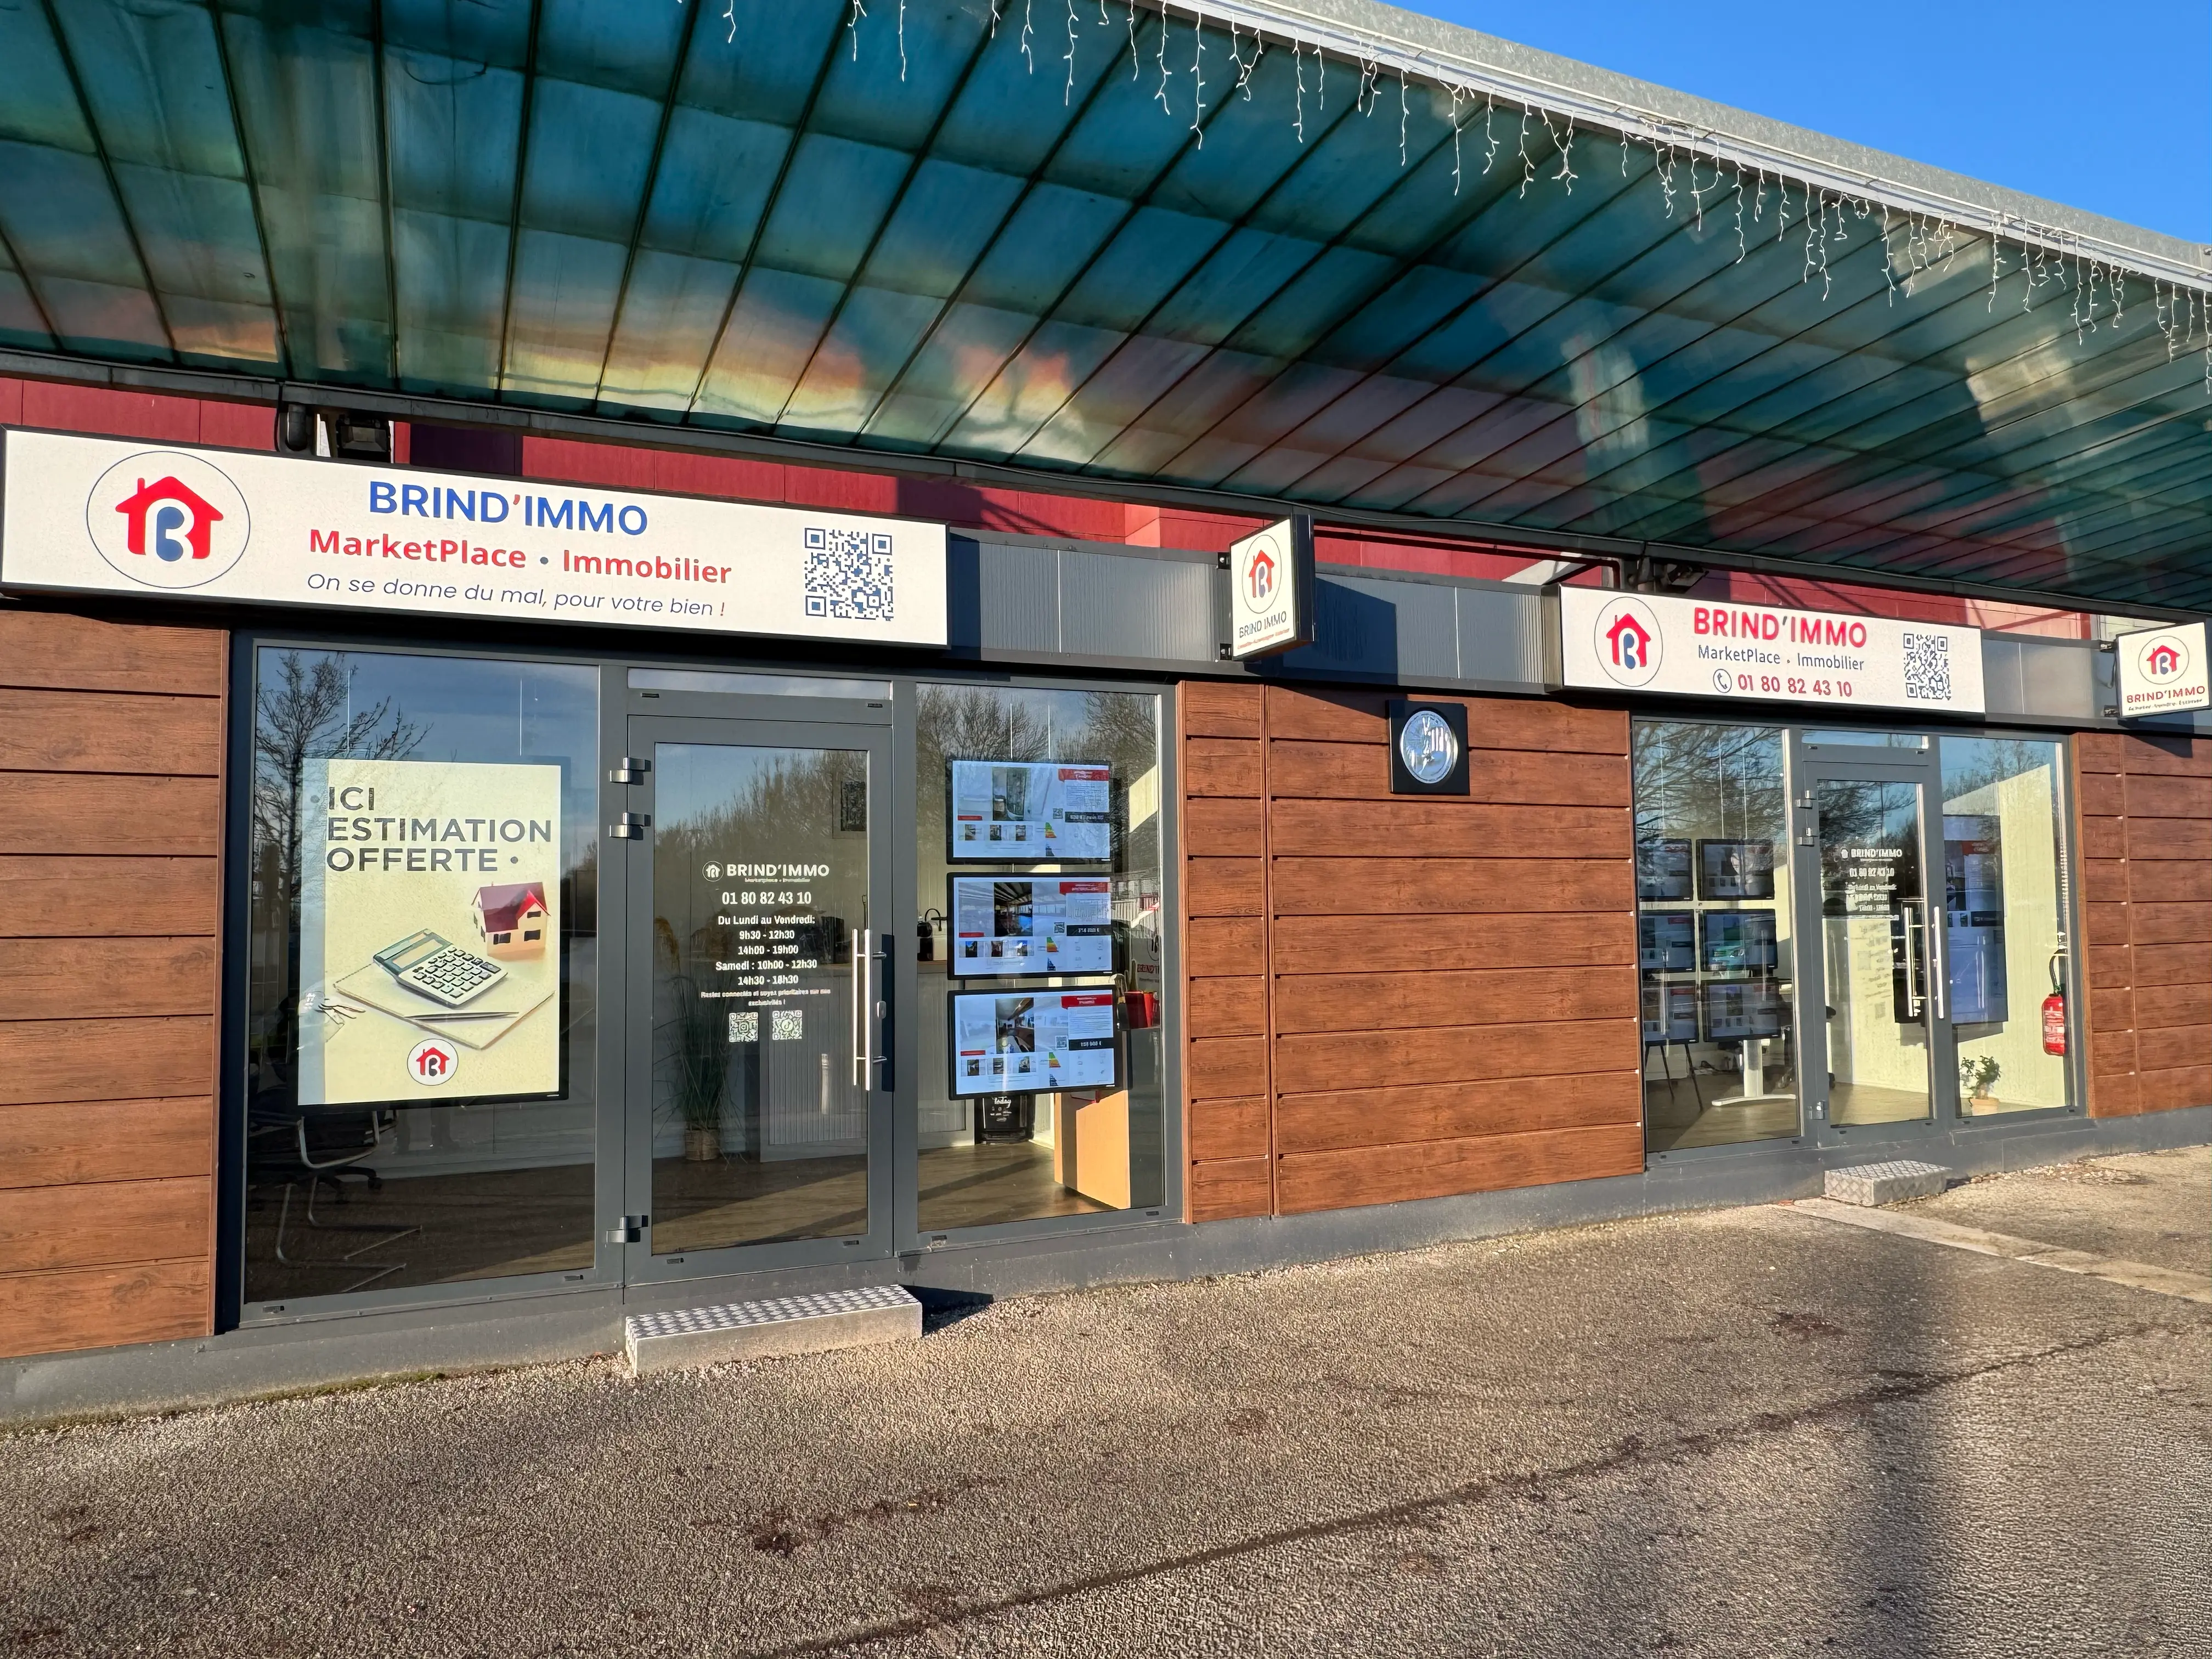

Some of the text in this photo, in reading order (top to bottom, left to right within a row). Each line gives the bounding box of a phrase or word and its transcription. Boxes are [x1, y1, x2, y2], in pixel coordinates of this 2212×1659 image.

[370, 481, 647, 535] BRIND'IMMO
[310, 529, 526, 568] MarketPlace
[564, 550, 732, 583] Immobilier
[308, 574, 339, 591] On
[348, 579, 375, 592] se
[383, 579, 456, 599] donne
[465, 584, 493, 601] du
[501, 589, 546, 607] mal,
[554, 594, 605, 611] pour
[612, 596, 663, 612] votre
[670, 599, 713, 616] bien
[1694, 607, 1867, 648] BRIND'IMMO
[1699, 645, 1780, 664] MarketPlace
[1797, 653, 1865, 671] Immobilier
[1738, 674, 1852, 697] 01 80 82 43 10
[2127, 686, 2205, 703] BRIND'IMMO
[329, 787, 374, 811] ICI
[328, 817, 551, 843] ESTIMATION
[326, 847, 498, 872] OFFERTE
[727, 864, 830, 877] BRIND'IMMO
[722, 891, 812, 904] 01 80 82 43 10
[718, 916, 731, 925] Du
[769, 930, 795, 940] 12h30
